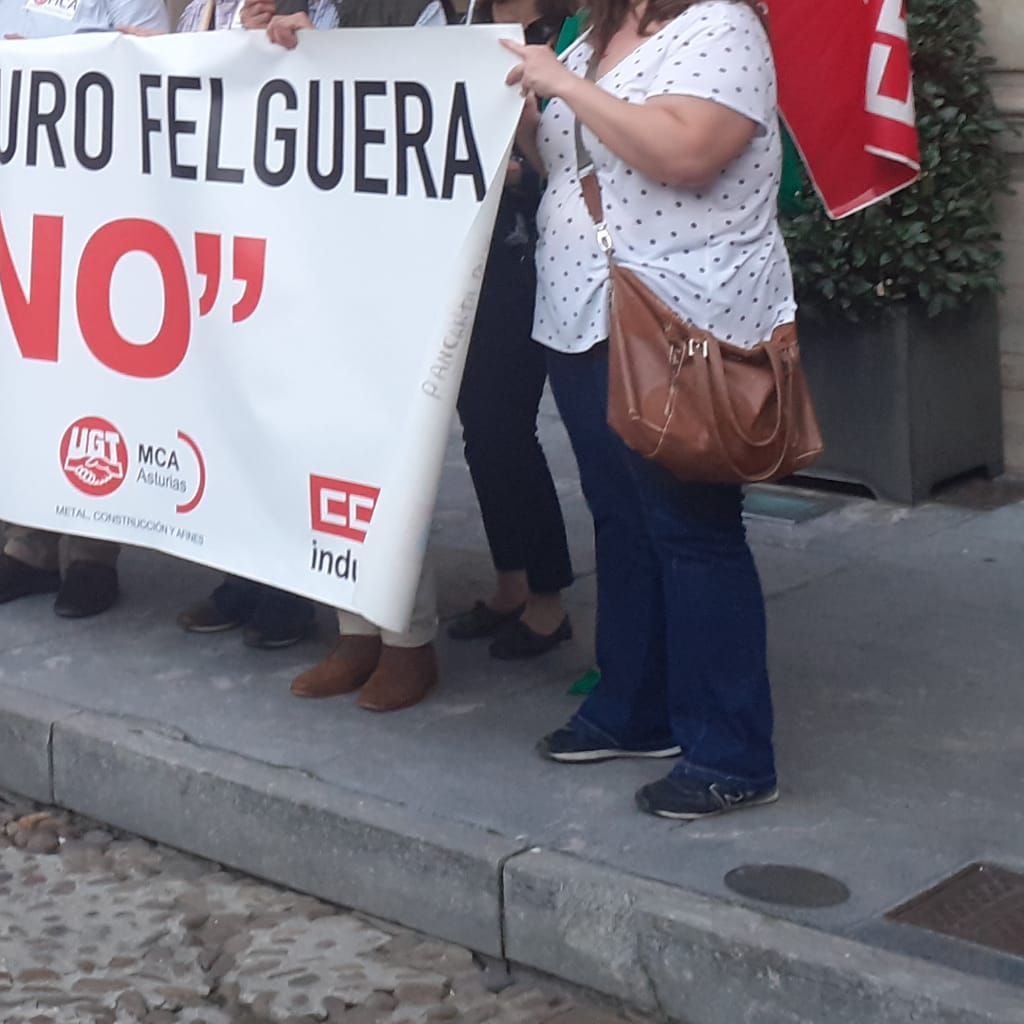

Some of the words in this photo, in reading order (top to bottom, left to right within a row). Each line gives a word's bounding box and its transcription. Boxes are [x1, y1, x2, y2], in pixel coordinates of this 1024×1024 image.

[139, 73, 486, 203] FELGUERA
[68, 426, 120, 465] UGT
[138, 443, 180, 472] MCA
[136, 467, 188, 494] Asturias
